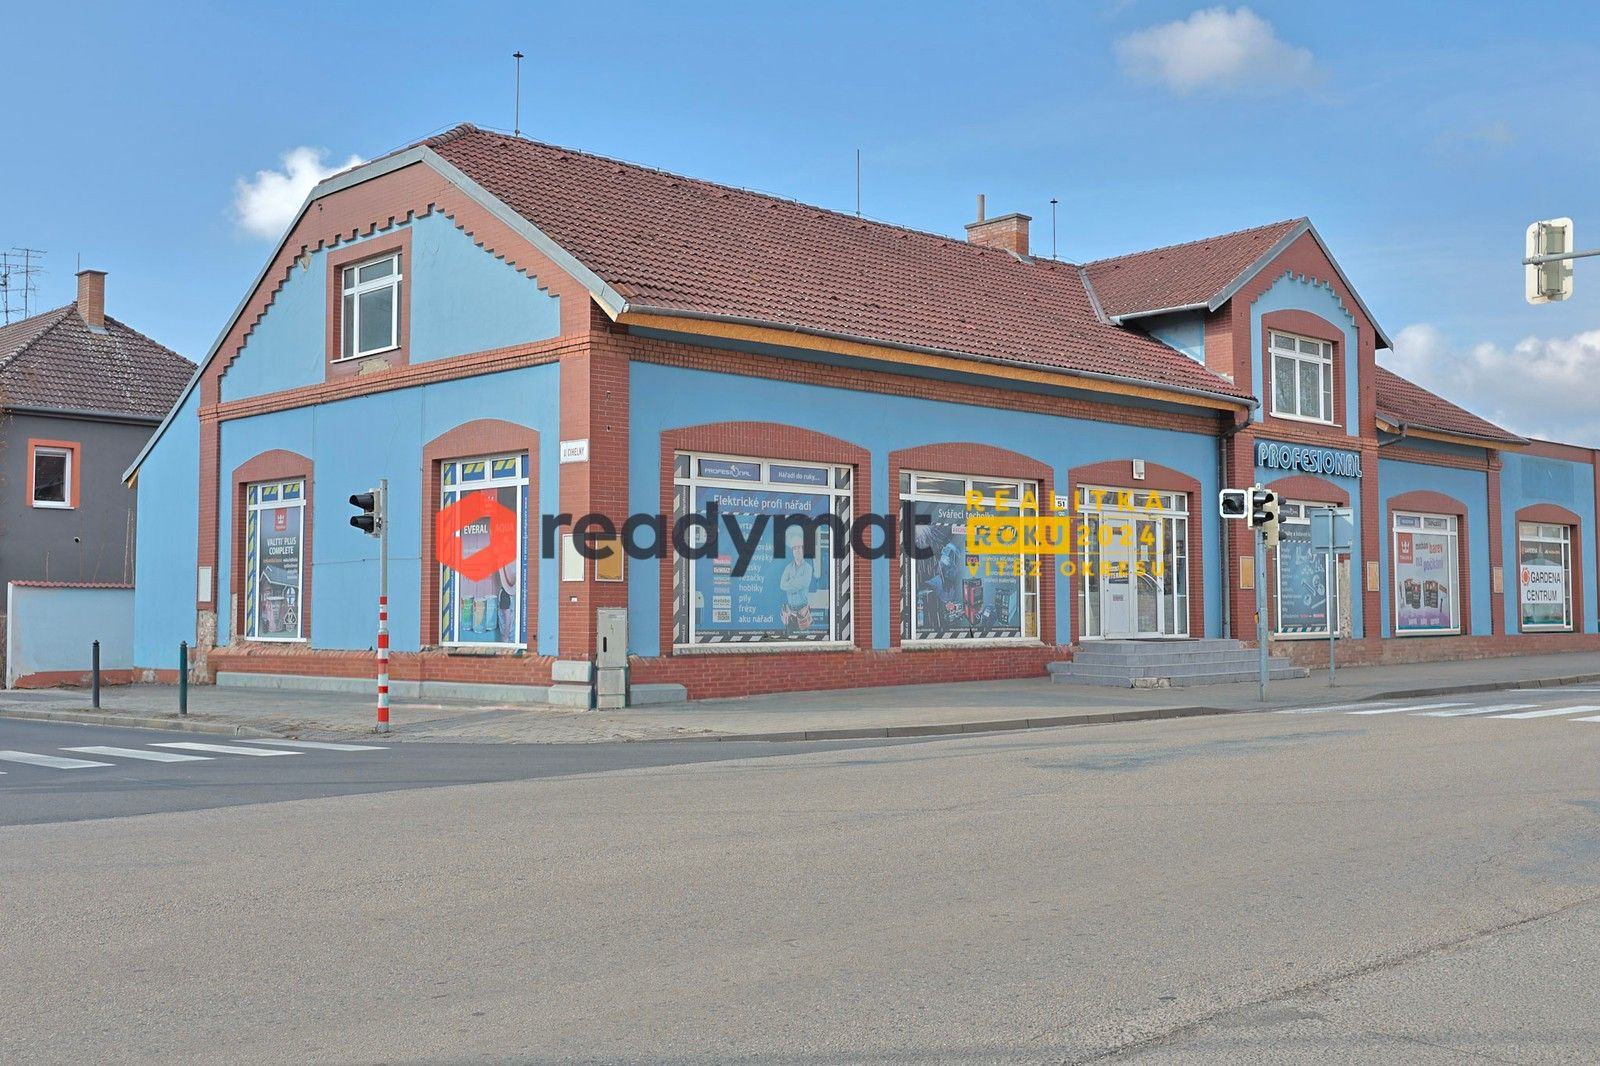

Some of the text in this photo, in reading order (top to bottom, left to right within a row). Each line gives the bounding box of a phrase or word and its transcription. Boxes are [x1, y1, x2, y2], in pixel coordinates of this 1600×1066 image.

[1258, 442, 1362, 477] PROFESIONAL
[714, 495, 759, 508] Elektrické
[762, 498, 782, 510] profi
[464, 524, 488, 534] EVERAL
[1531, 572, 1561, 583] GARDENA
[1527, 590, 1557, 601] CENTRUM
